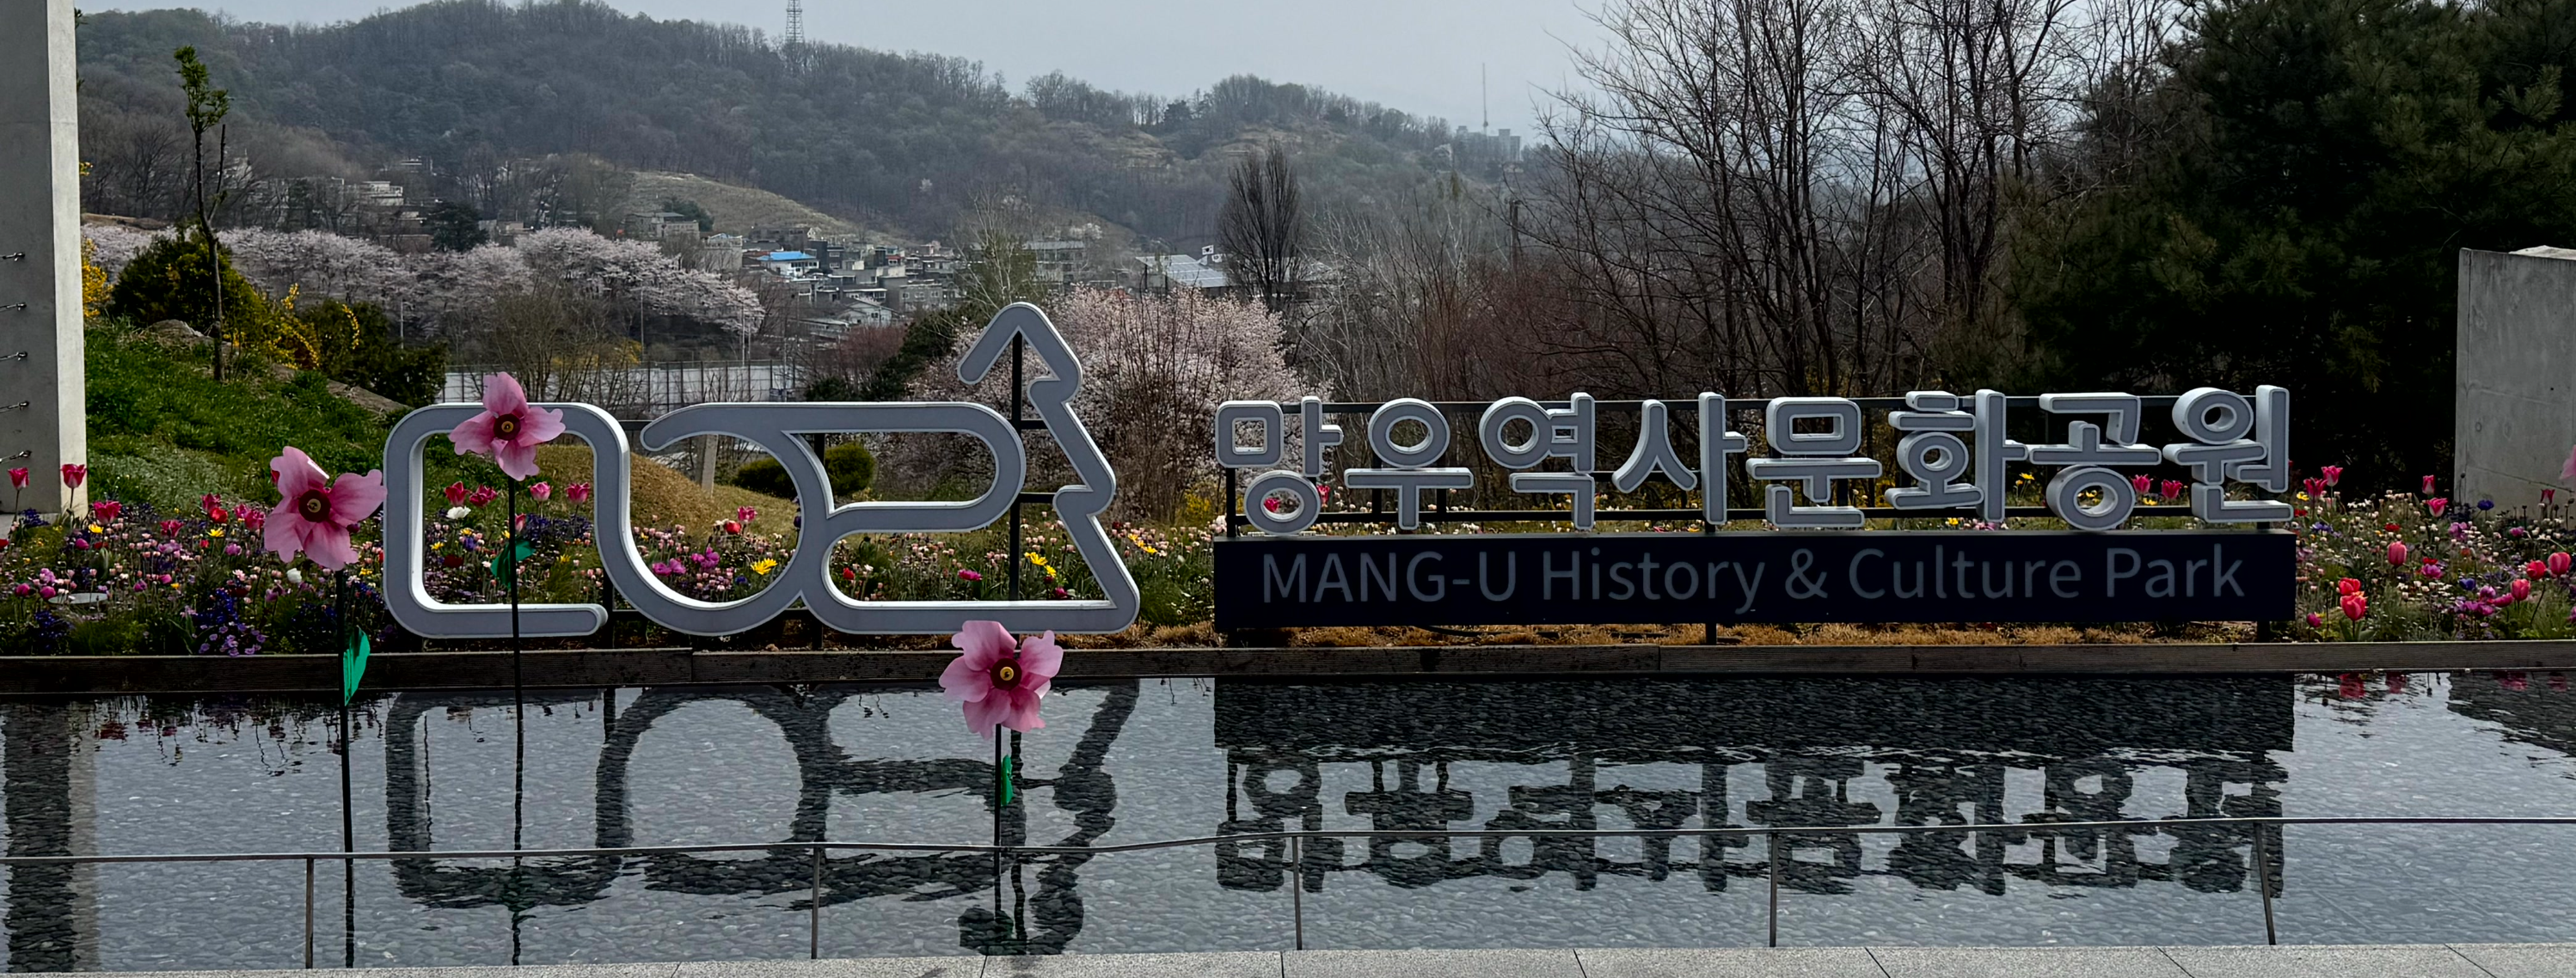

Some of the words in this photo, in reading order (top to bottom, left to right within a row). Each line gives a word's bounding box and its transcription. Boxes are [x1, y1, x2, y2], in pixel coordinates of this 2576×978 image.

[1215, 384, 2294, 535] 망우역사문화공원
[1263, 551, 1517, 603] MANG-U
[1543, 547, 1765, 614] History
[1784, 548, 1827, 599] &
[1849, 543, 2082, 599] Culture
[2105, 543, 2245, 598] Park
